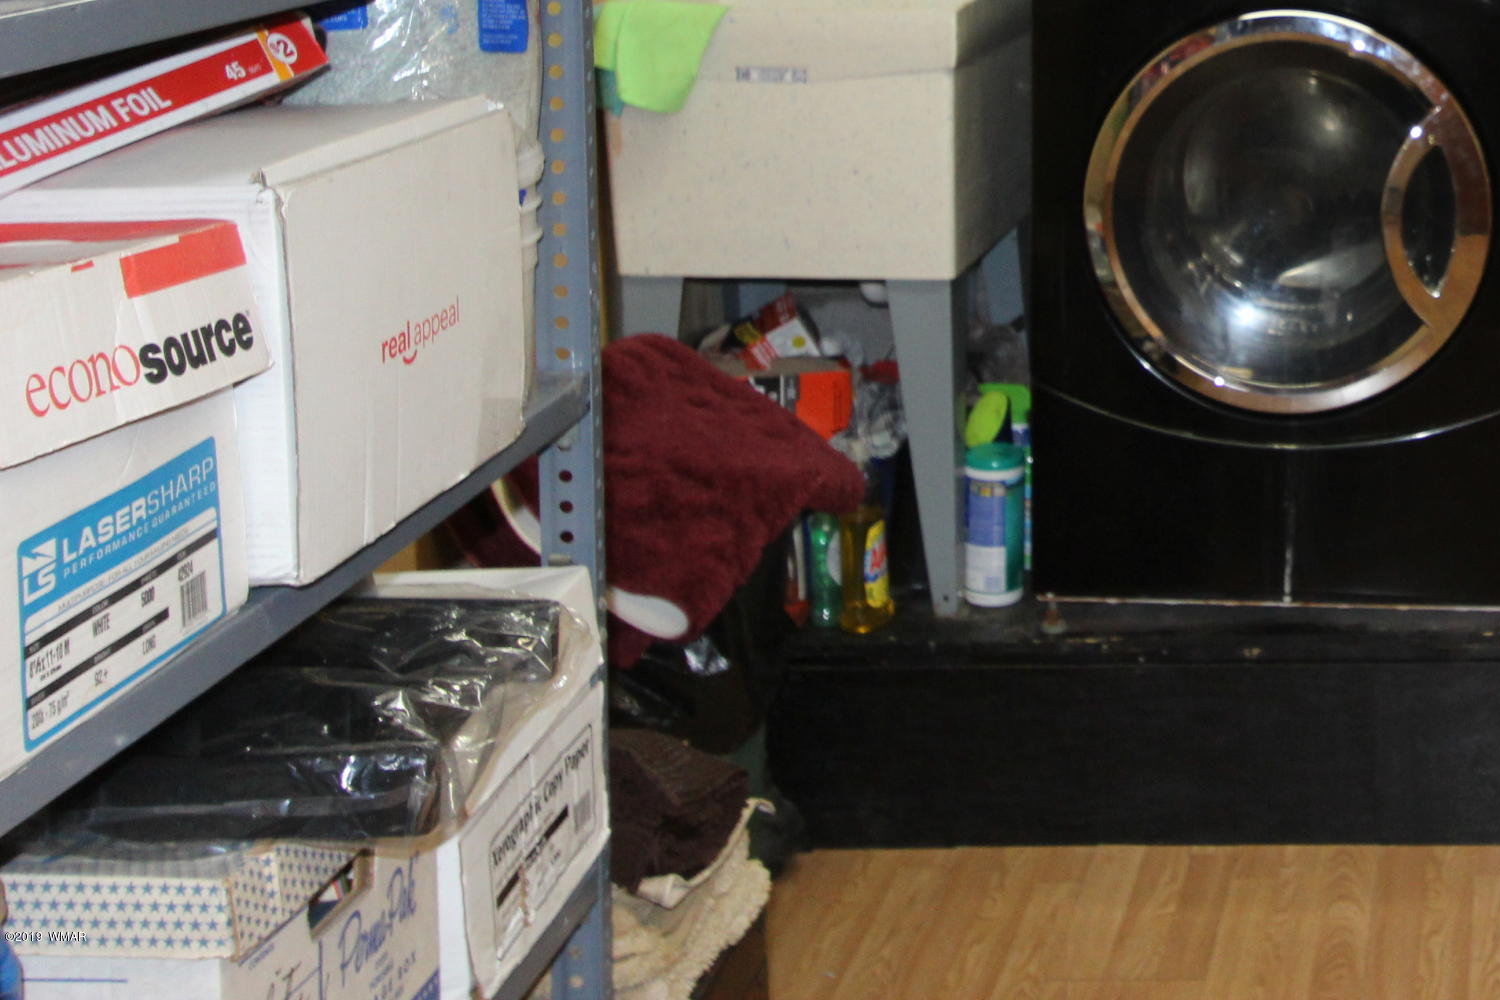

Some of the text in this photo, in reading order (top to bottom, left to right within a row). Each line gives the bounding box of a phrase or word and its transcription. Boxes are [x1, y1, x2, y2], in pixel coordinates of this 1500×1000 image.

[111, 86, 173, 123] FOIL
[381, 295, 460, 364] real appeal
[62, 456, 215, 564] LASERSHARP
[62, 523, 150, 579] PERFORMANCE
[151, 480, 217, 529] GUARANTEED
[25, 562, 58, 606] LS
